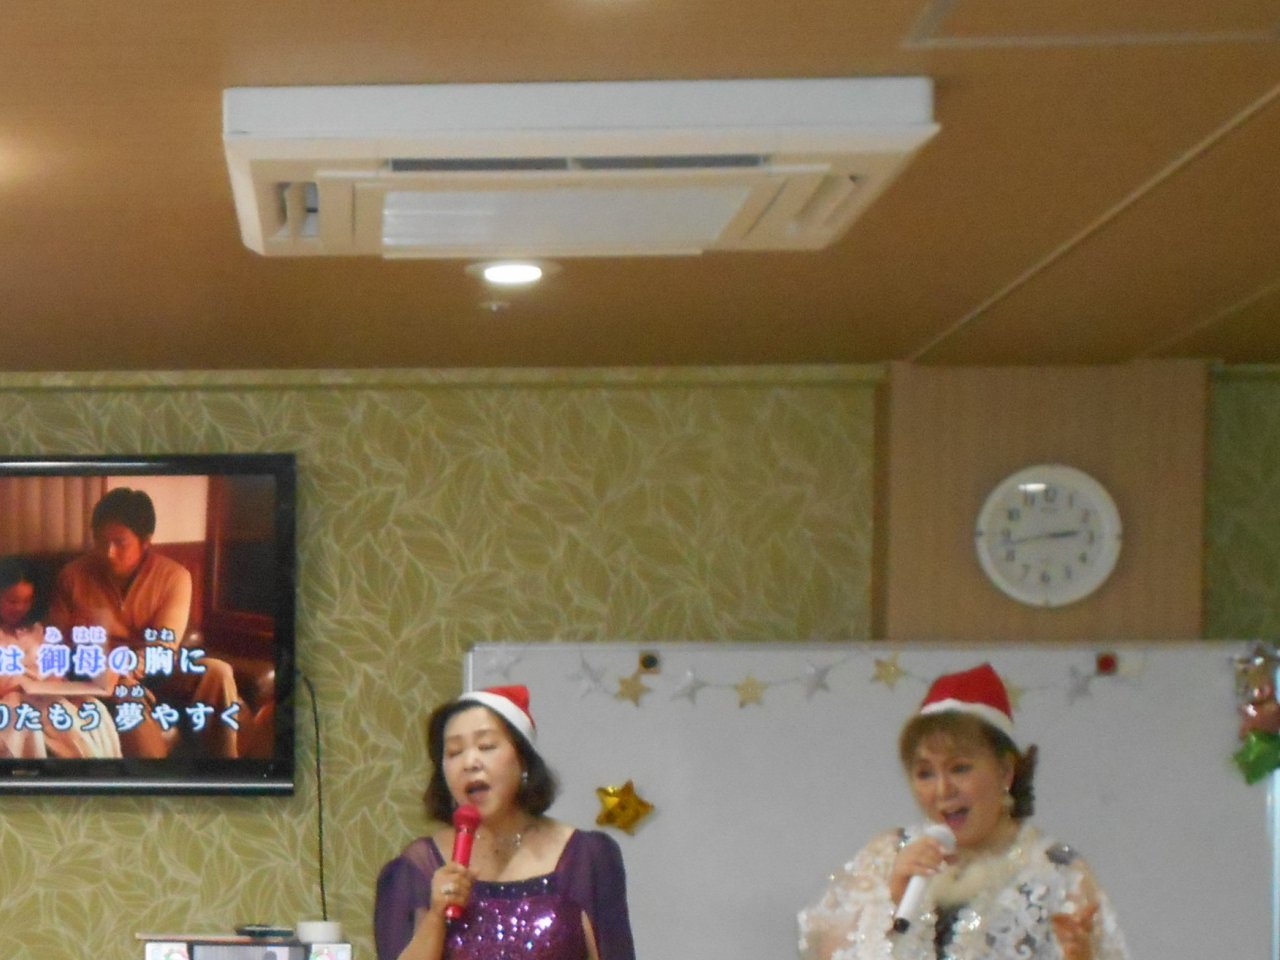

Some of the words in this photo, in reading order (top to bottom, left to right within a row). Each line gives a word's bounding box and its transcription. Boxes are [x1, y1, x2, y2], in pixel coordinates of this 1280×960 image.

[144, 628, 175, 641] むね
[39, 644, 207, 677] 御母の胸に
[115, 684, 145, 698] ゆめ
[115, 702, 240, 731] 夢やすく
